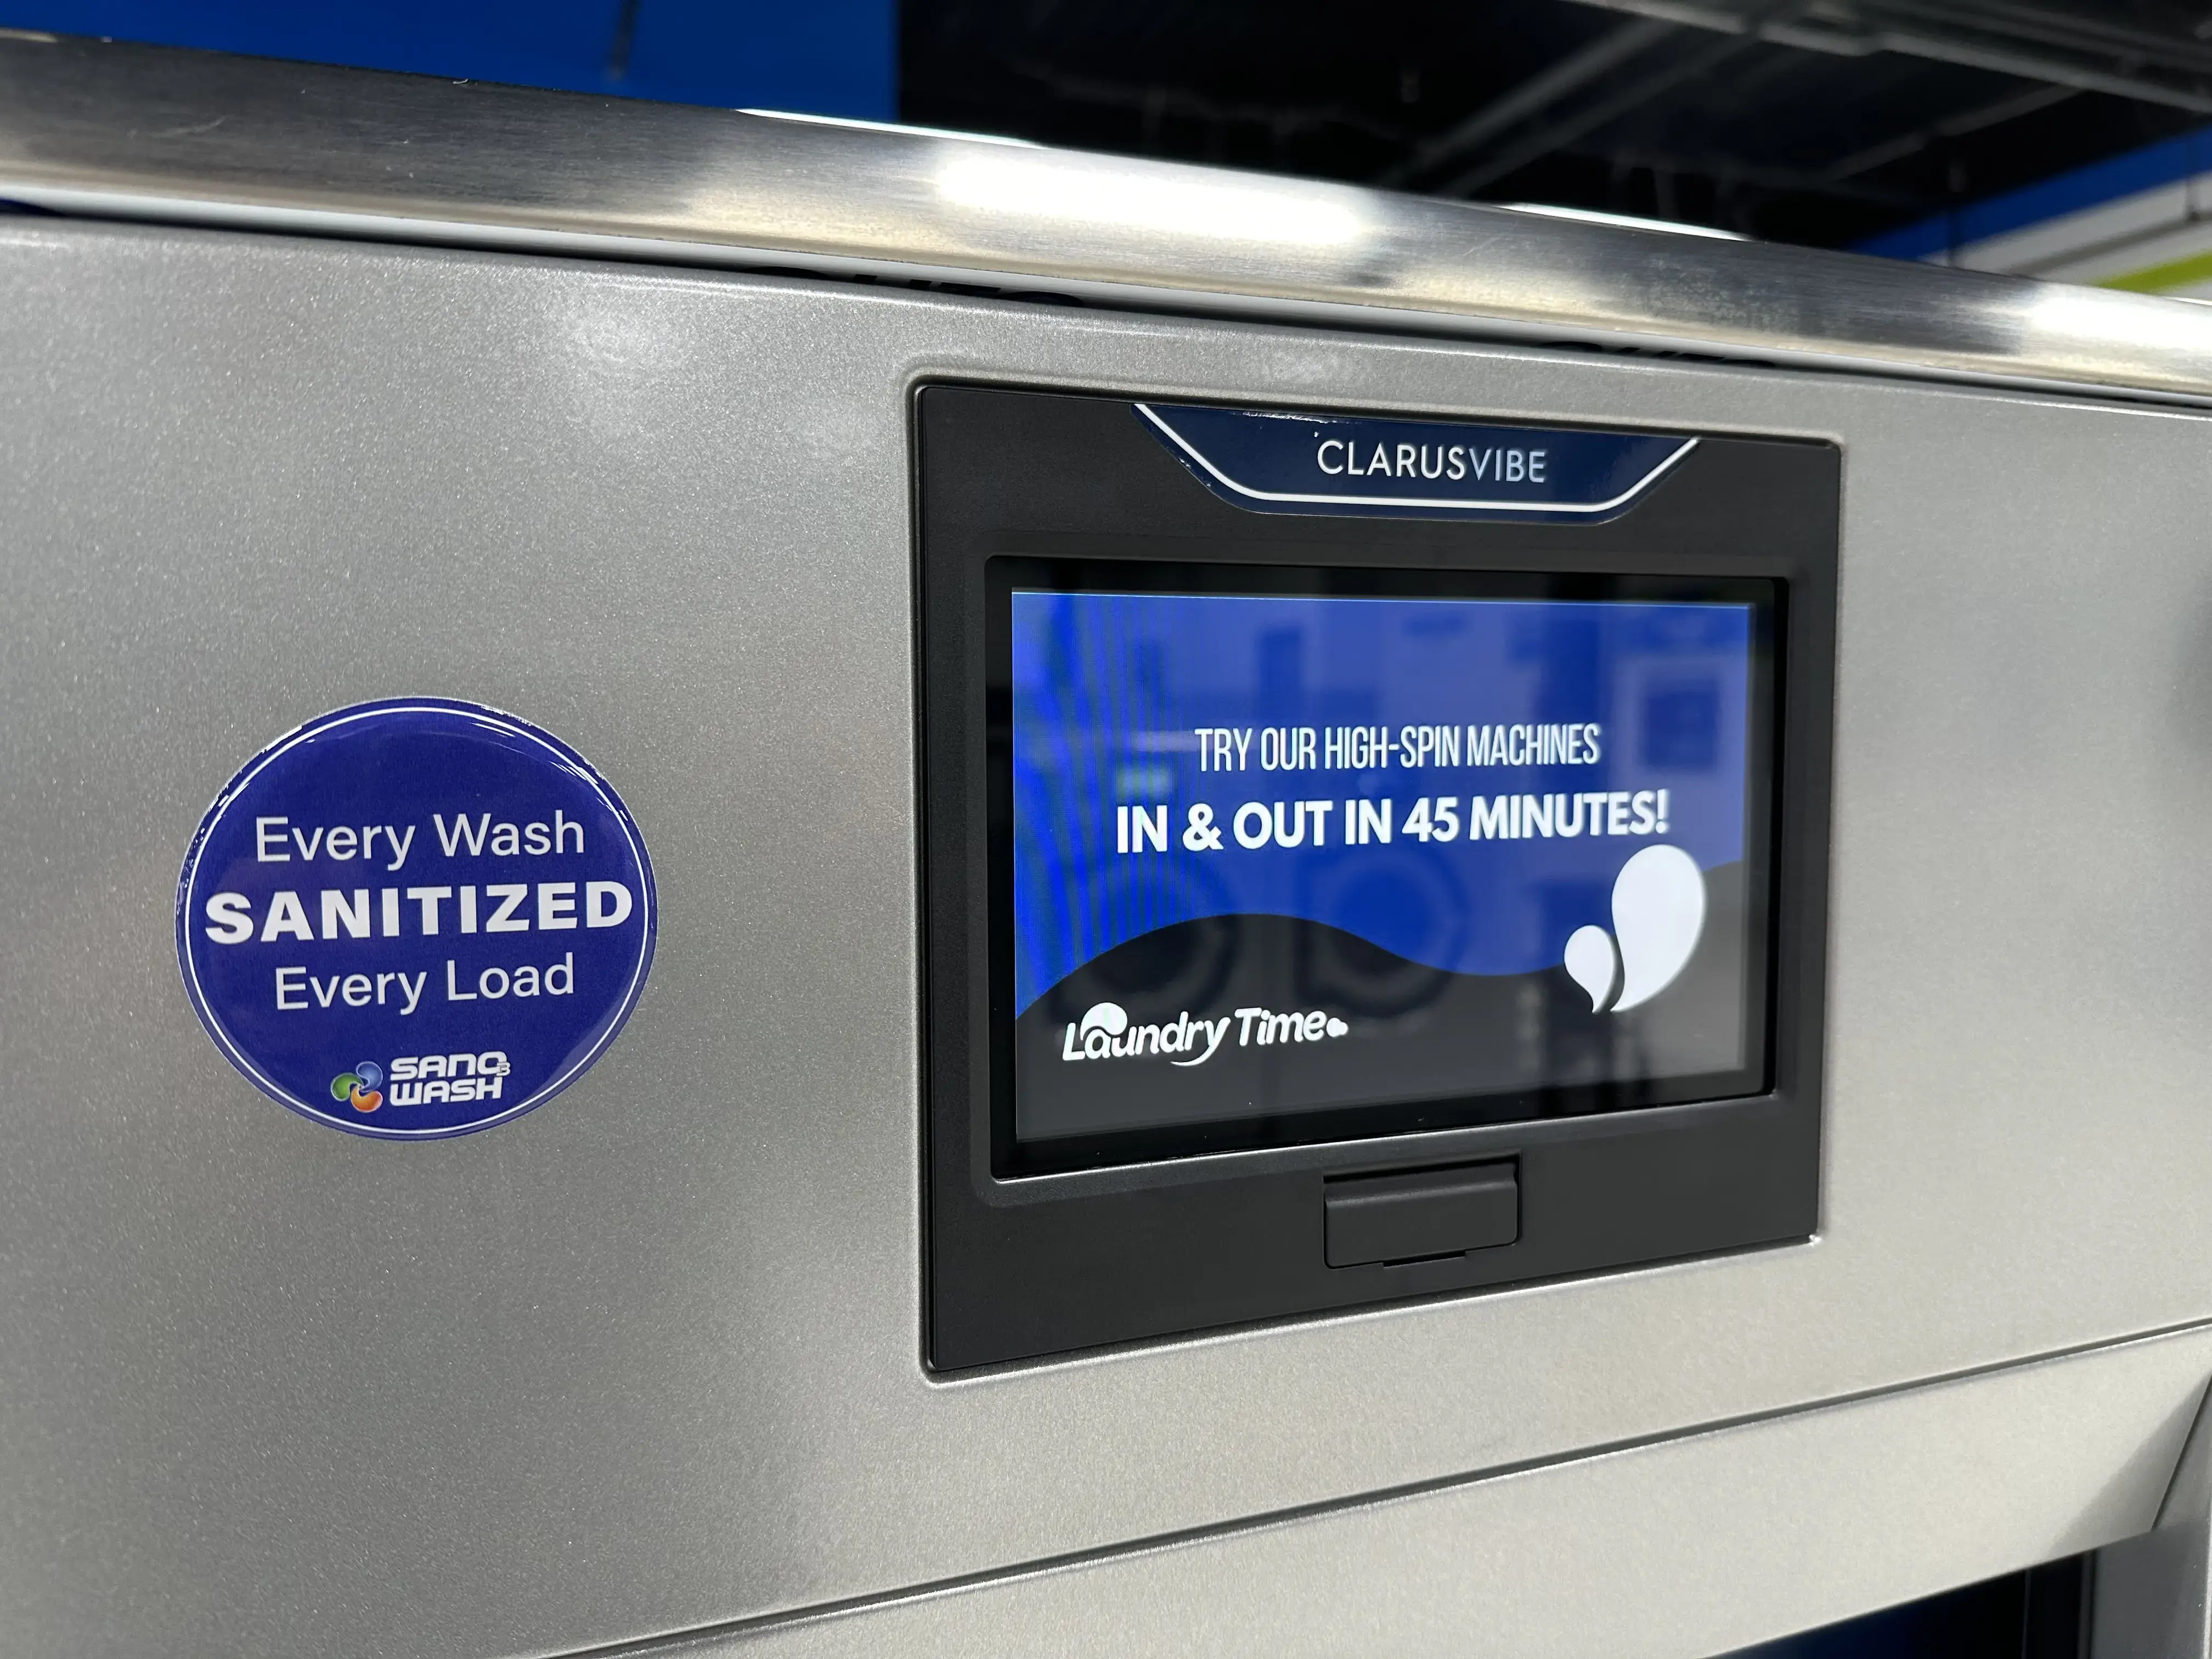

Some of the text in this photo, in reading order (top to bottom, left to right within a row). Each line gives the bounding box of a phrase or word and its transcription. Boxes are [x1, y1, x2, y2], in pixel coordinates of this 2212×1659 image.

[1194, 723, 1600, 772] TRY OUR HIGH-SPIN MACHINES
[256, 810, 584, 871] Every Wash
[1118, 789, 1669, 854] IN & OUT IN 45 MINUTES!
[205, 881, 633, 944] SANITIZED
[275, 952, 574, 1015] Every Load
[1062, 1006, 1328, 1066] Laundry Time
[390, 1076, 503, 1107] WASH
